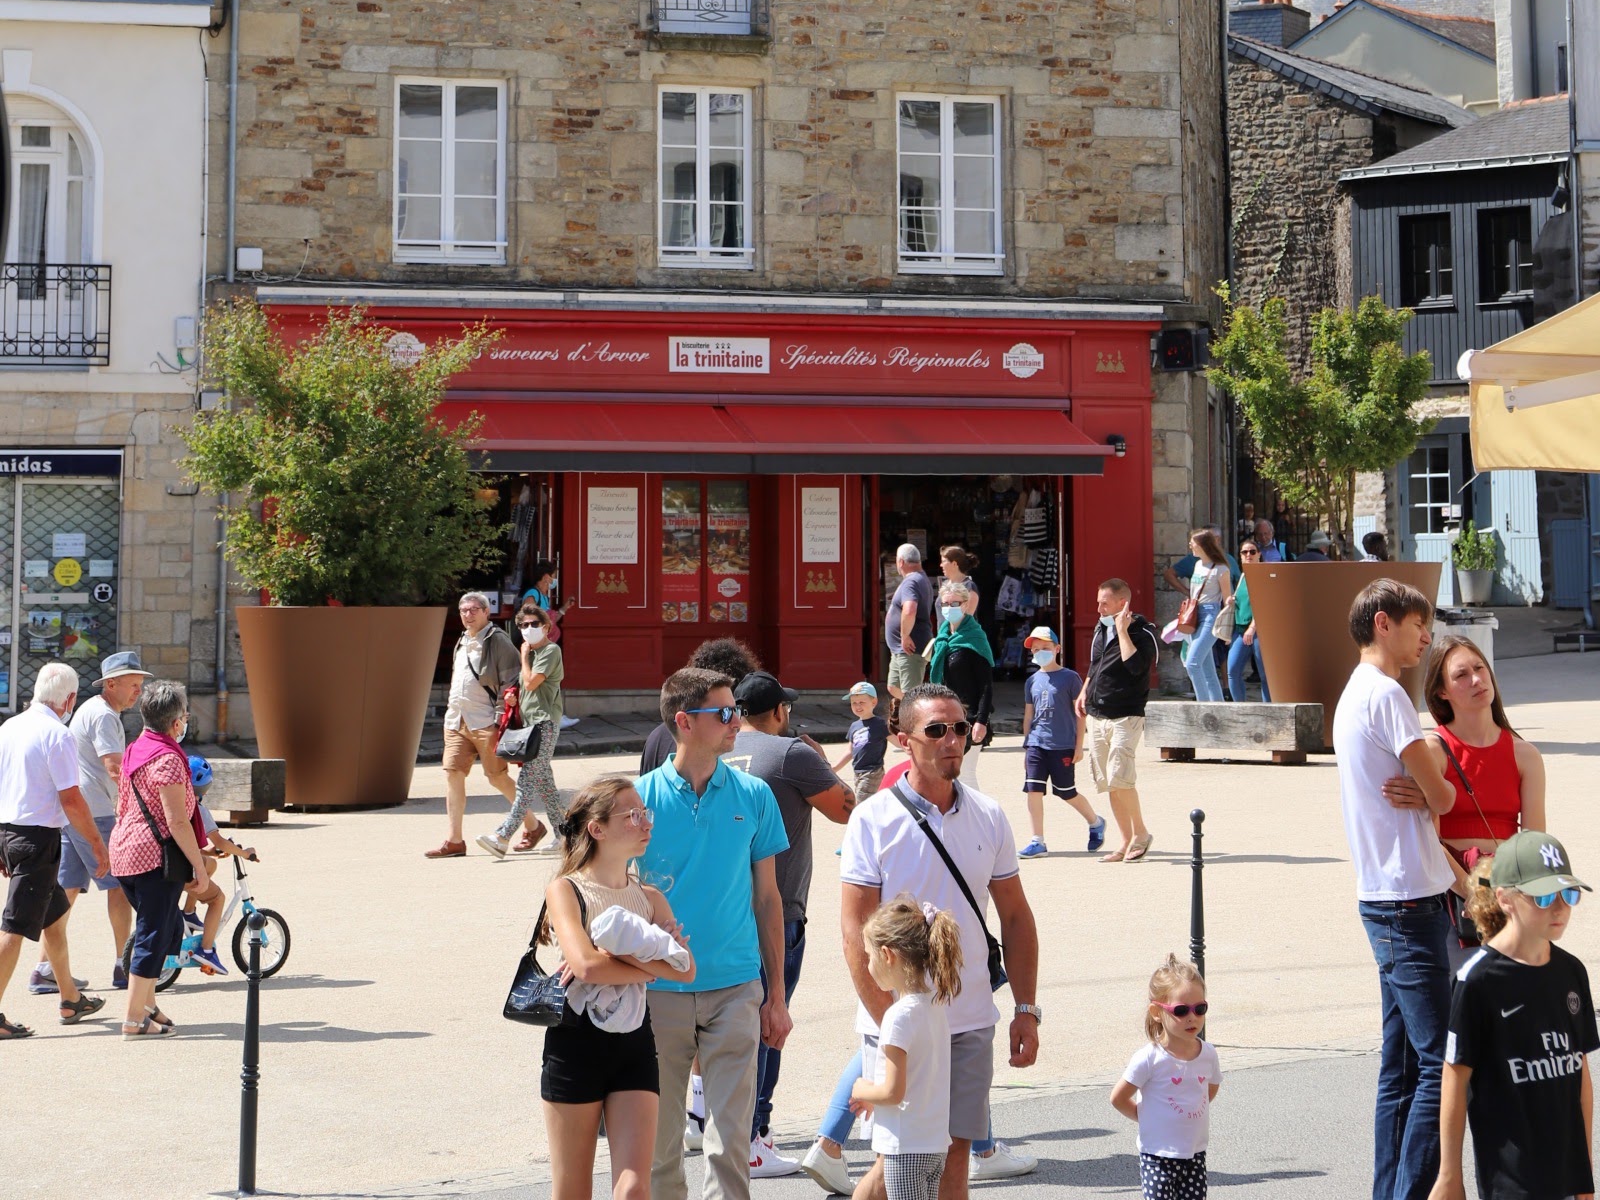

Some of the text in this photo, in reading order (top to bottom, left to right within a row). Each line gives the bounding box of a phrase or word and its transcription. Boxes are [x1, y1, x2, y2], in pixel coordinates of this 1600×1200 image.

[490, 348, 560, 361] saveurs
[567, 341, 651, 362] d'Arvor
[676, 342, 763, 368] la trinitaine
[780, 344, 990, 373] Spécialités Régionales
[1012, 359, 1042, 367] trinitaine
[1541, 1031, 1569, 1051] Fly
[1507, 1051, 1584, 1084] Emiras
